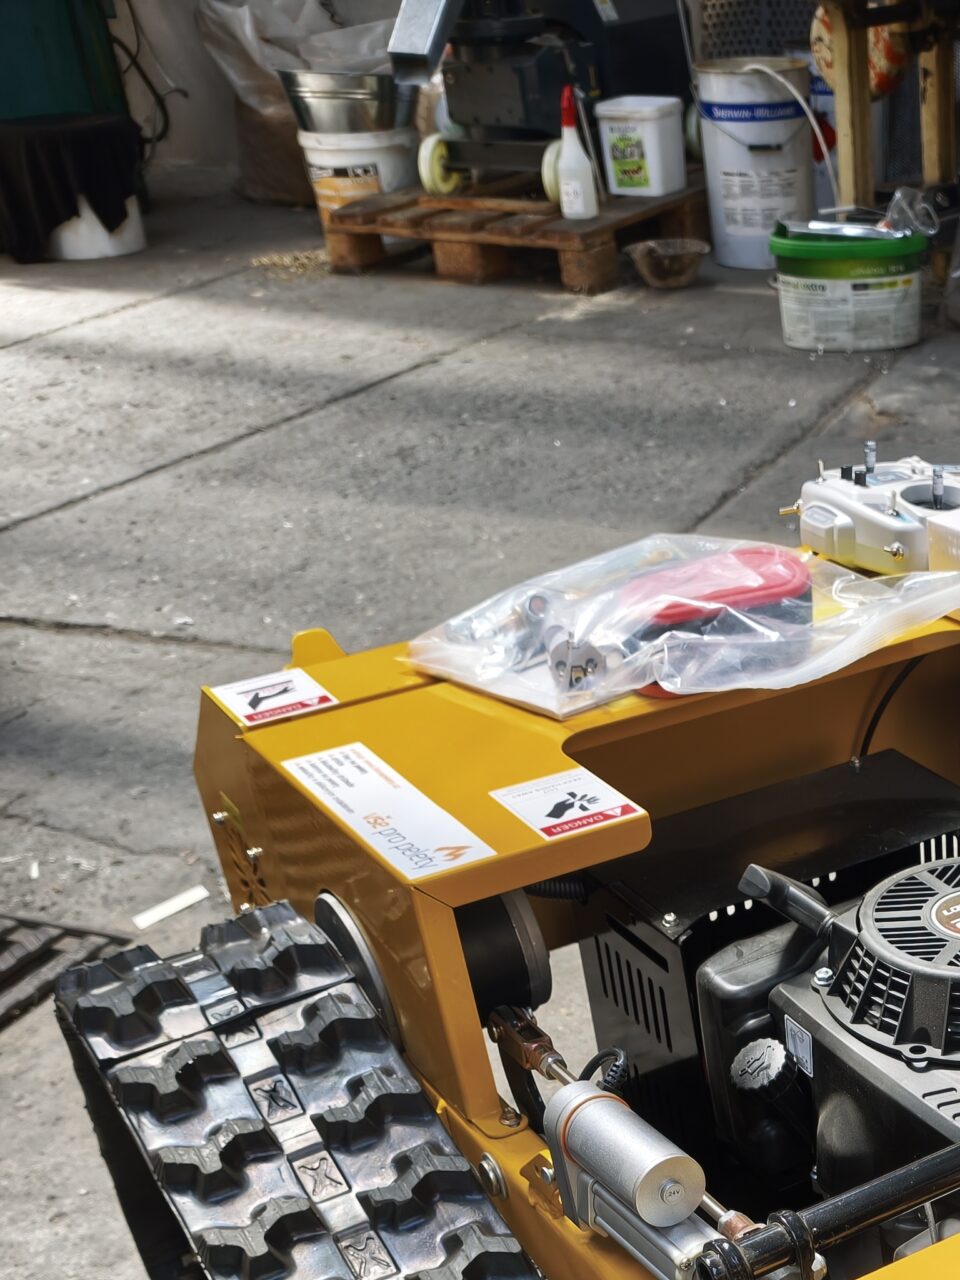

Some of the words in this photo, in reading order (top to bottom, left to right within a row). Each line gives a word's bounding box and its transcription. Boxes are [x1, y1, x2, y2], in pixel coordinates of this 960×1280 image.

[363, 812, 391, 829] vše
[551, 815, 604, 833] DANGER
[371, 828, 406, 844] pro
[388, 842, 439, 870] pelety
[668, 1189, 680, 1197] 24V
